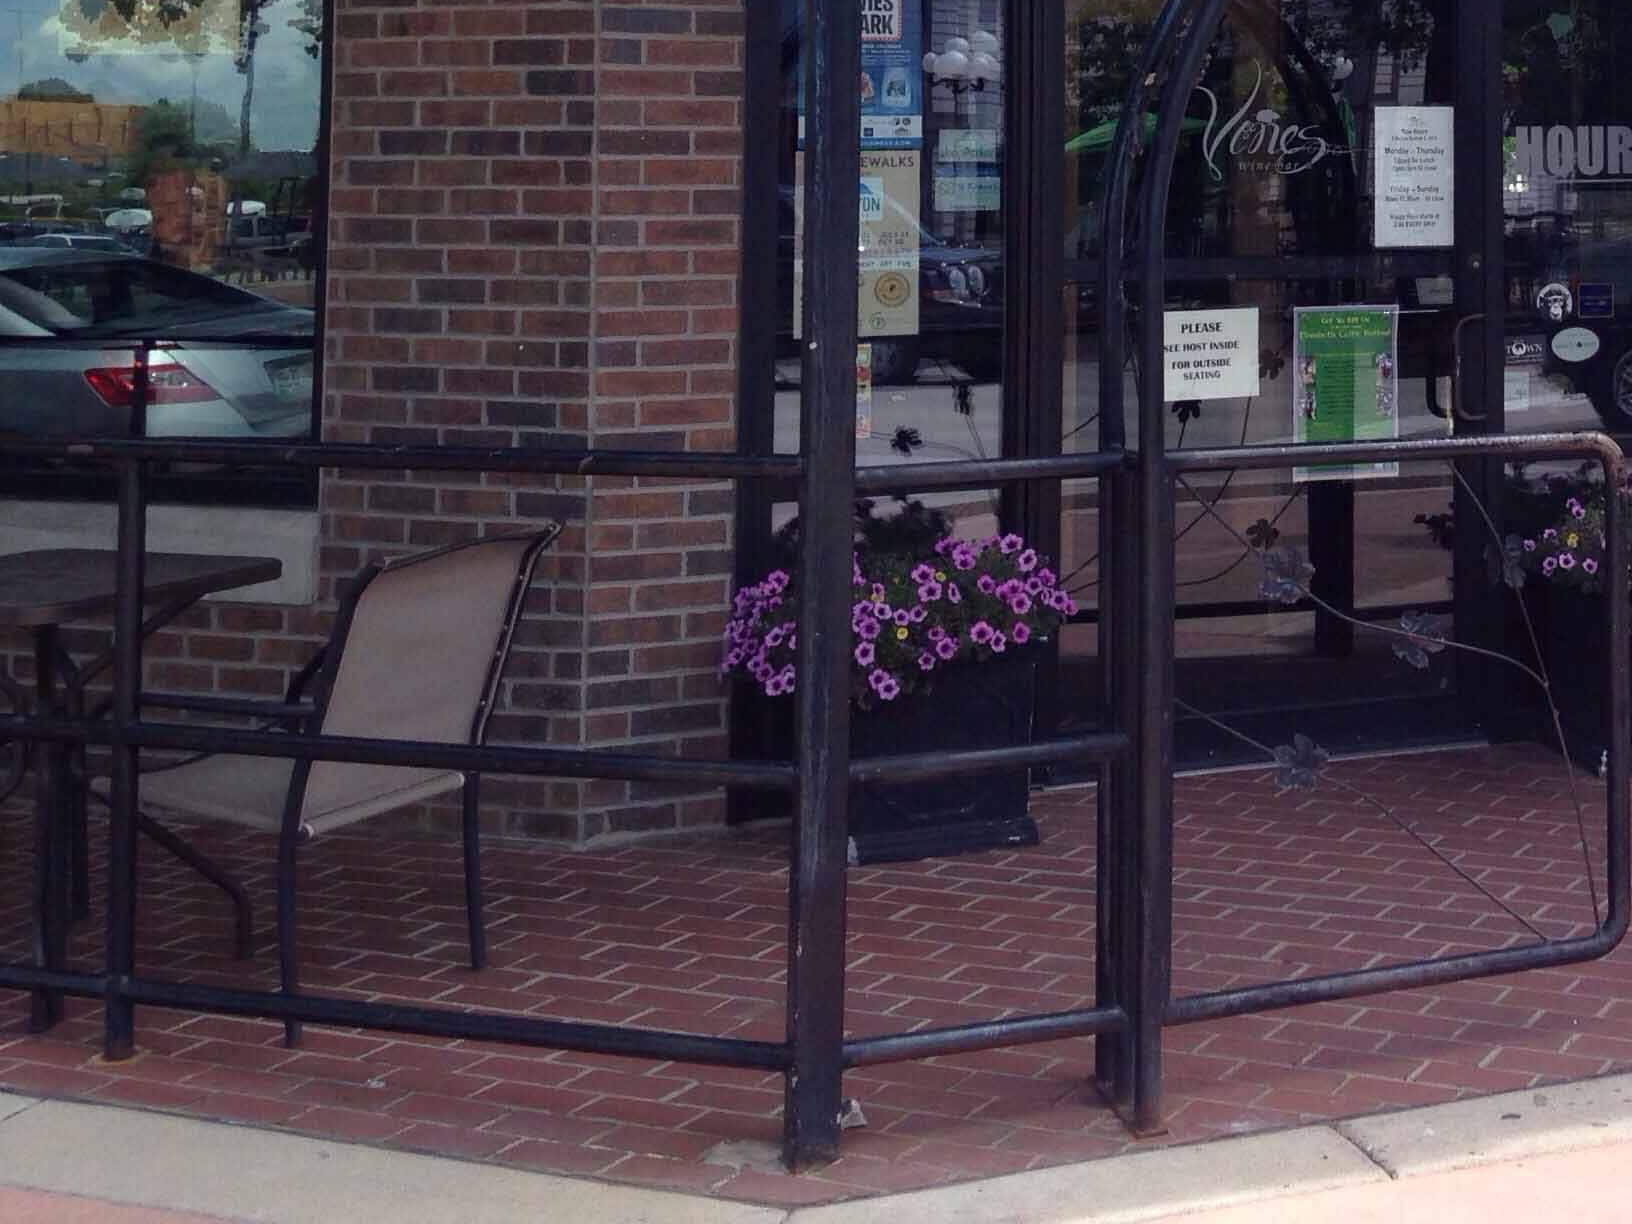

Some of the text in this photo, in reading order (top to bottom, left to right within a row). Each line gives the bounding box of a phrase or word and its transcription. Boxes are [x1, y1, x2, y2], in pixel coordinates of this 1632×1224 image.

[861, 14, 893, 35] ARK
[861, 156, 914, 168] EWALKS
[1181, 321, 1224, 334] PLEASE
[1164, 341, 1240, 353] SEE HOST INSIDE
[1171, 358, 1232, 370] FOR OUTSIDE
[1183, 370, 1221, 381] SEATING
